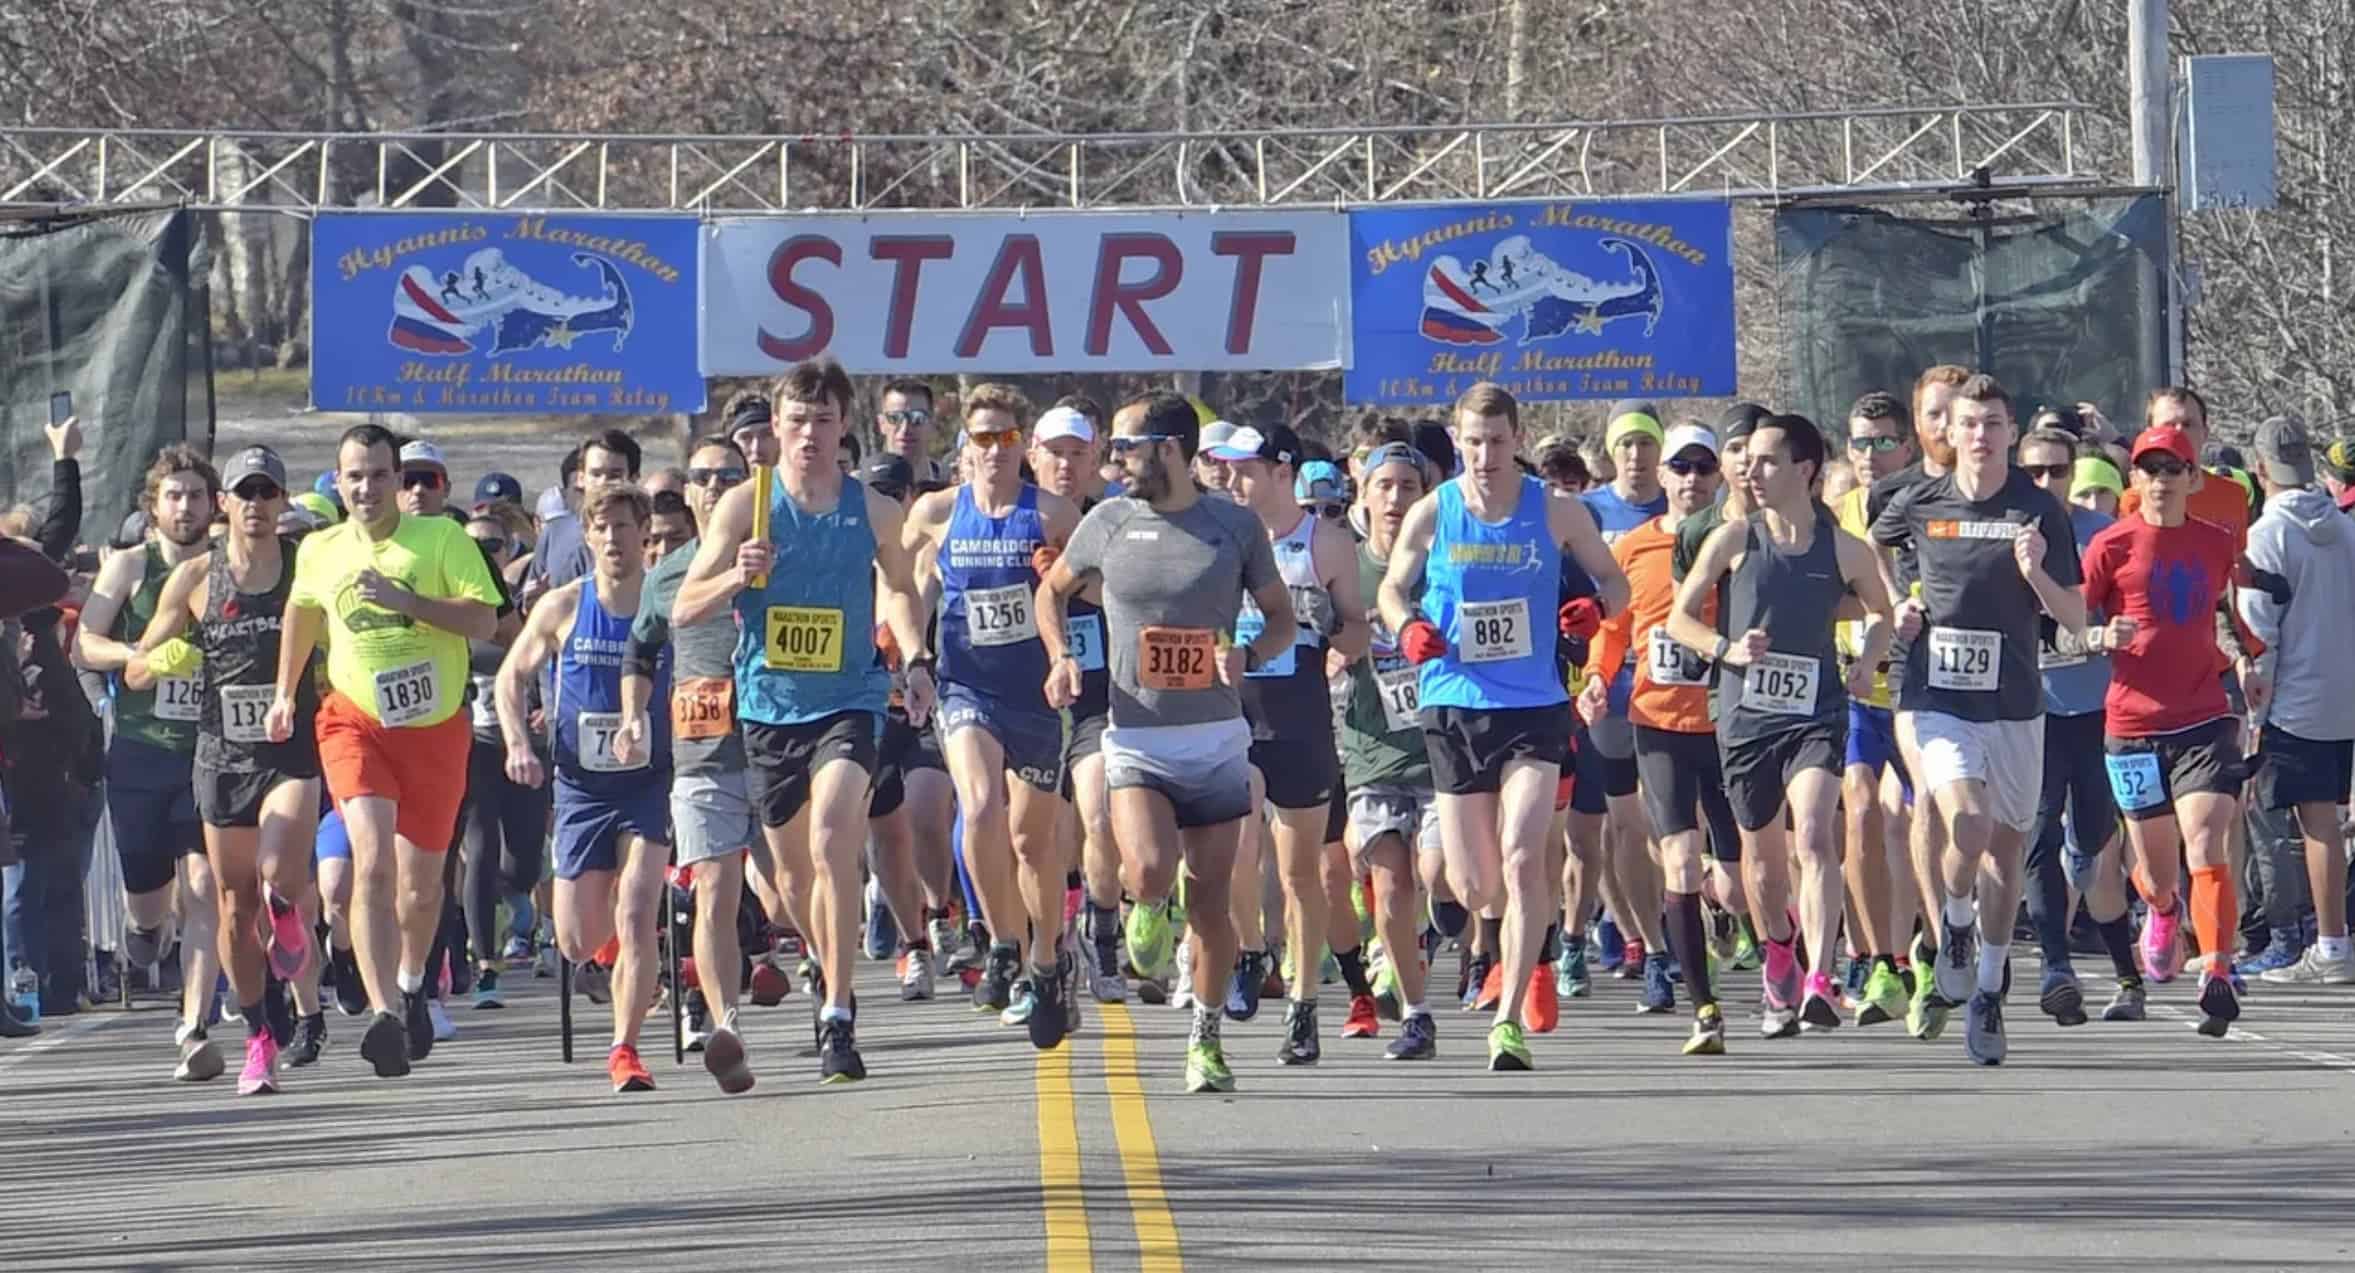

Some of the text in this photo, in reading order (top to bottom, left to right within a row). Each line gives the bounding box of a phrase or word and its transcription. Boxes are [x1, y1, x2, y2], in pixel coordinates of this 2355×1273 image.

[337, 217, 680, 284] Hyannis Marathon
[1366, 203, 1708, 275] Hyannis Marathon
[757, 230, 1297, 363] START
[395, 361, 623, 386] Half Marathon
[1426, 350, 1655, 377] Half Marathon
[440, 385, 537, 406] Marathon
[609, 386, 670, 410] Relay
[1640, 373, 1702, 395] Relay
[950, 538, 1040, 554] CAMBRIDGE
[951, 555, 1004, 568] RUNNING
[975, 601, 1026, 630] 1256
[776, 625, 833, 655] 4007
[1475, 617, 1515, 646] 882
[1149, 646, 1204, 675] 3182
[1938, 647, 1990, 674] 1129
[383, 675, 433, 712] 1830
[1753, 668, 1809, 700] 1052
